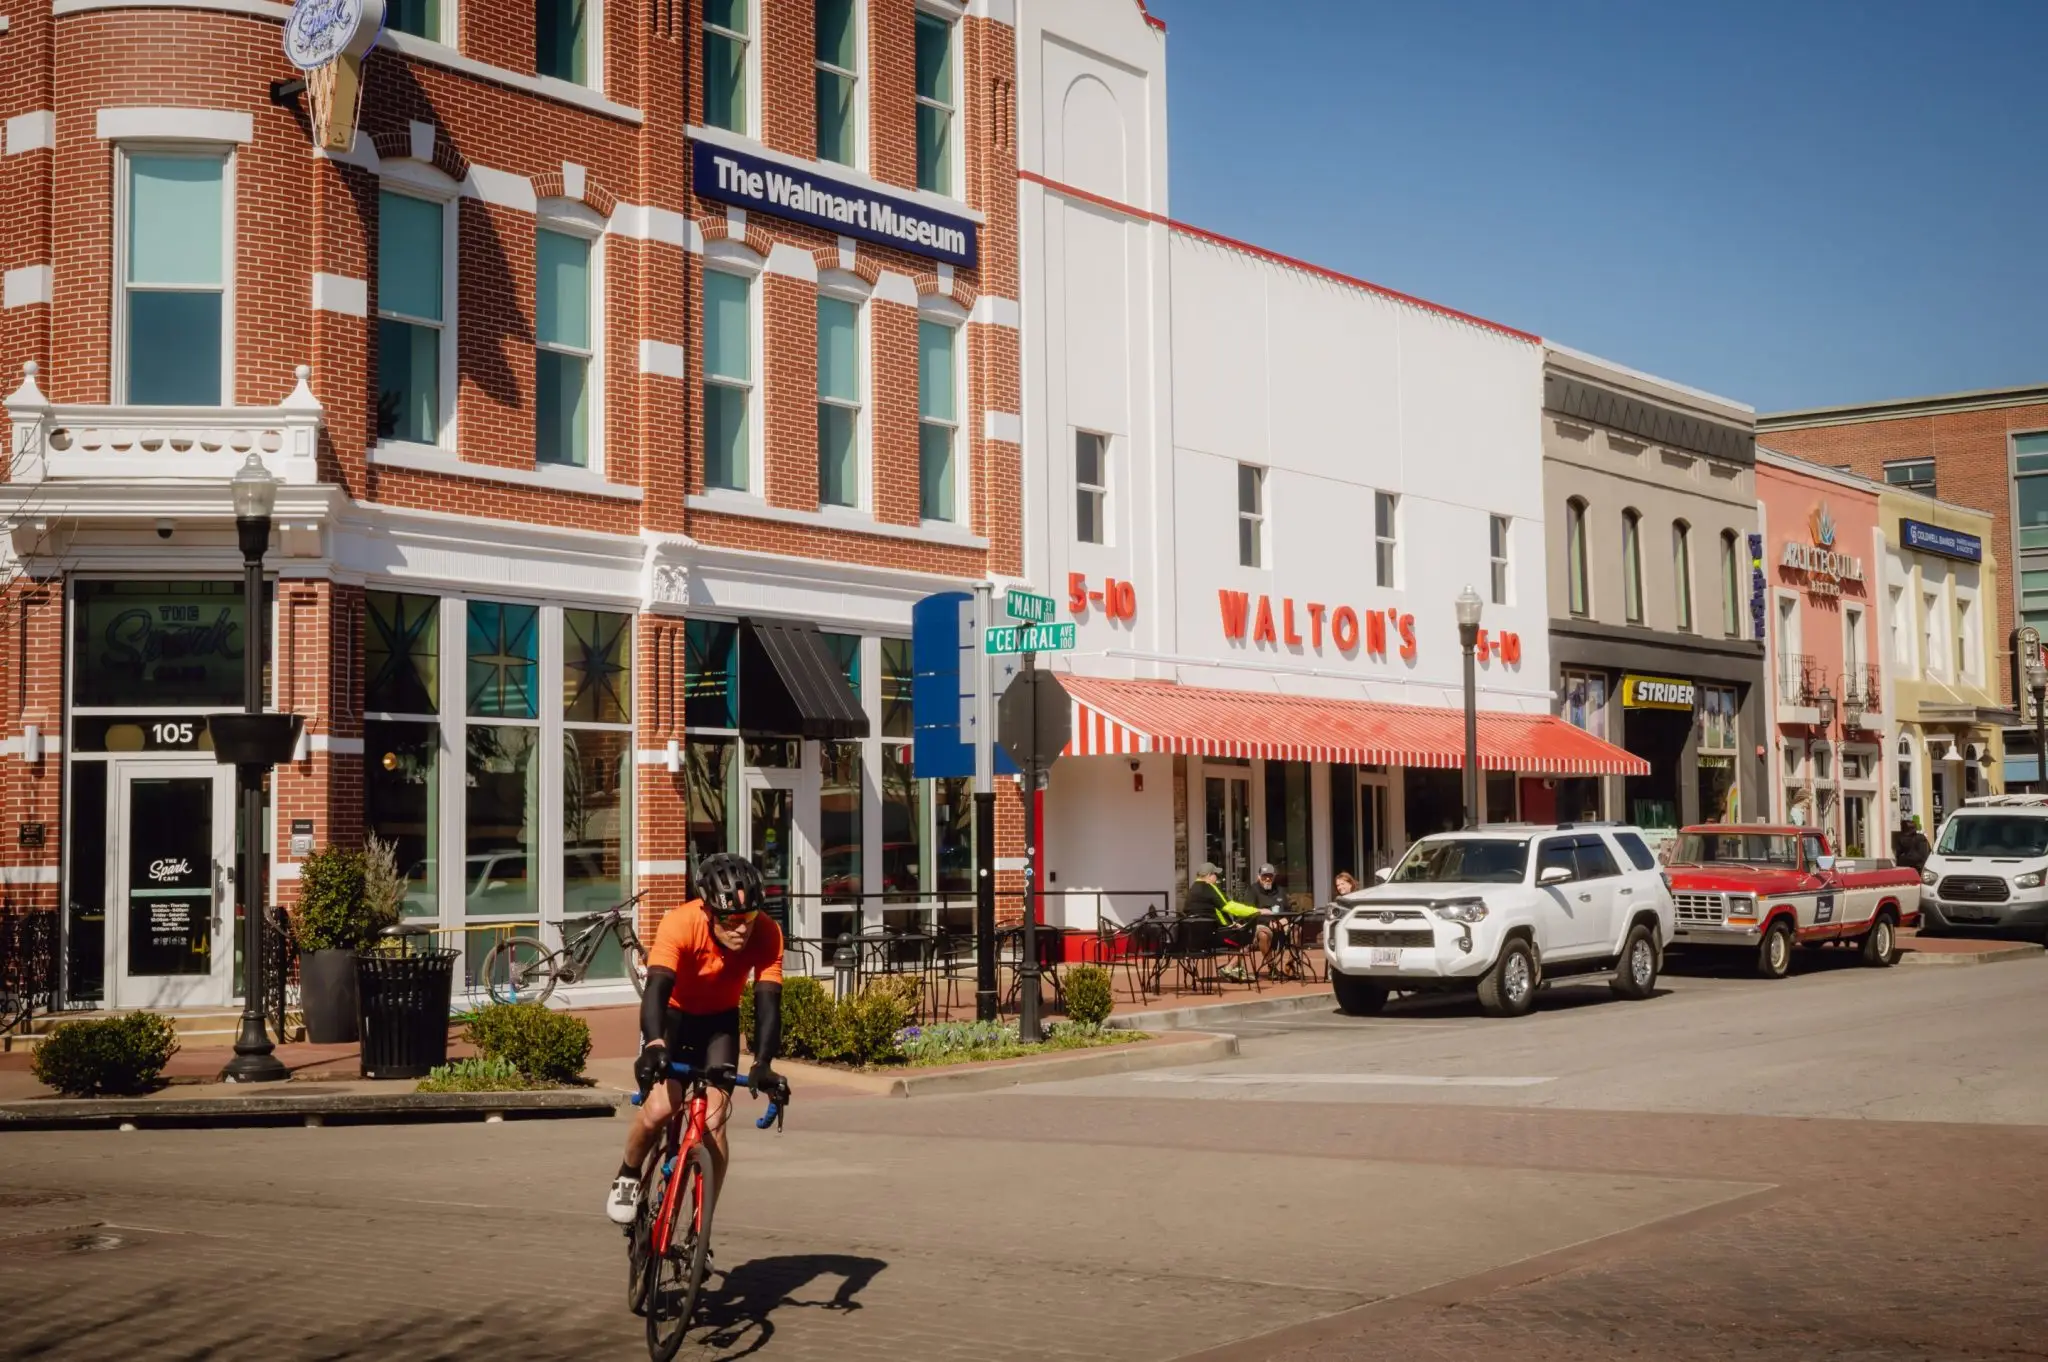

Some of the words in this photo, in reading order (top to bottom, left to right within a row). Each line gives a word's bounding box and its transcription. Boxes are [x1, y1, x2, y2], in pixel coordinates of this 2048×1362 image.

[713, 156, 764, 199] The
[765, 171, 868, 229] Walmart
[871, 202, 966, 255] Museum
[1014, 594, 1042, 621] MAIN
[1045, 600, 1053, 613] ST
[1068, 572, 1136, 621] 5-10
[988, 631, 994, 642] W
[996, 627, 1056, 651] CENTRAL
[1060, 625, 1074, 637] AVE
[1218, 589, 1417, 661] WALTON'S
[1060, 637, 1073, 649] 100
[1477, 629, 1521, 664] 5-10
[1638, 681, 1695, 704] STRIDER
[152, 723, 193, 743] 105
[149, 858, 192, 881] Spark
